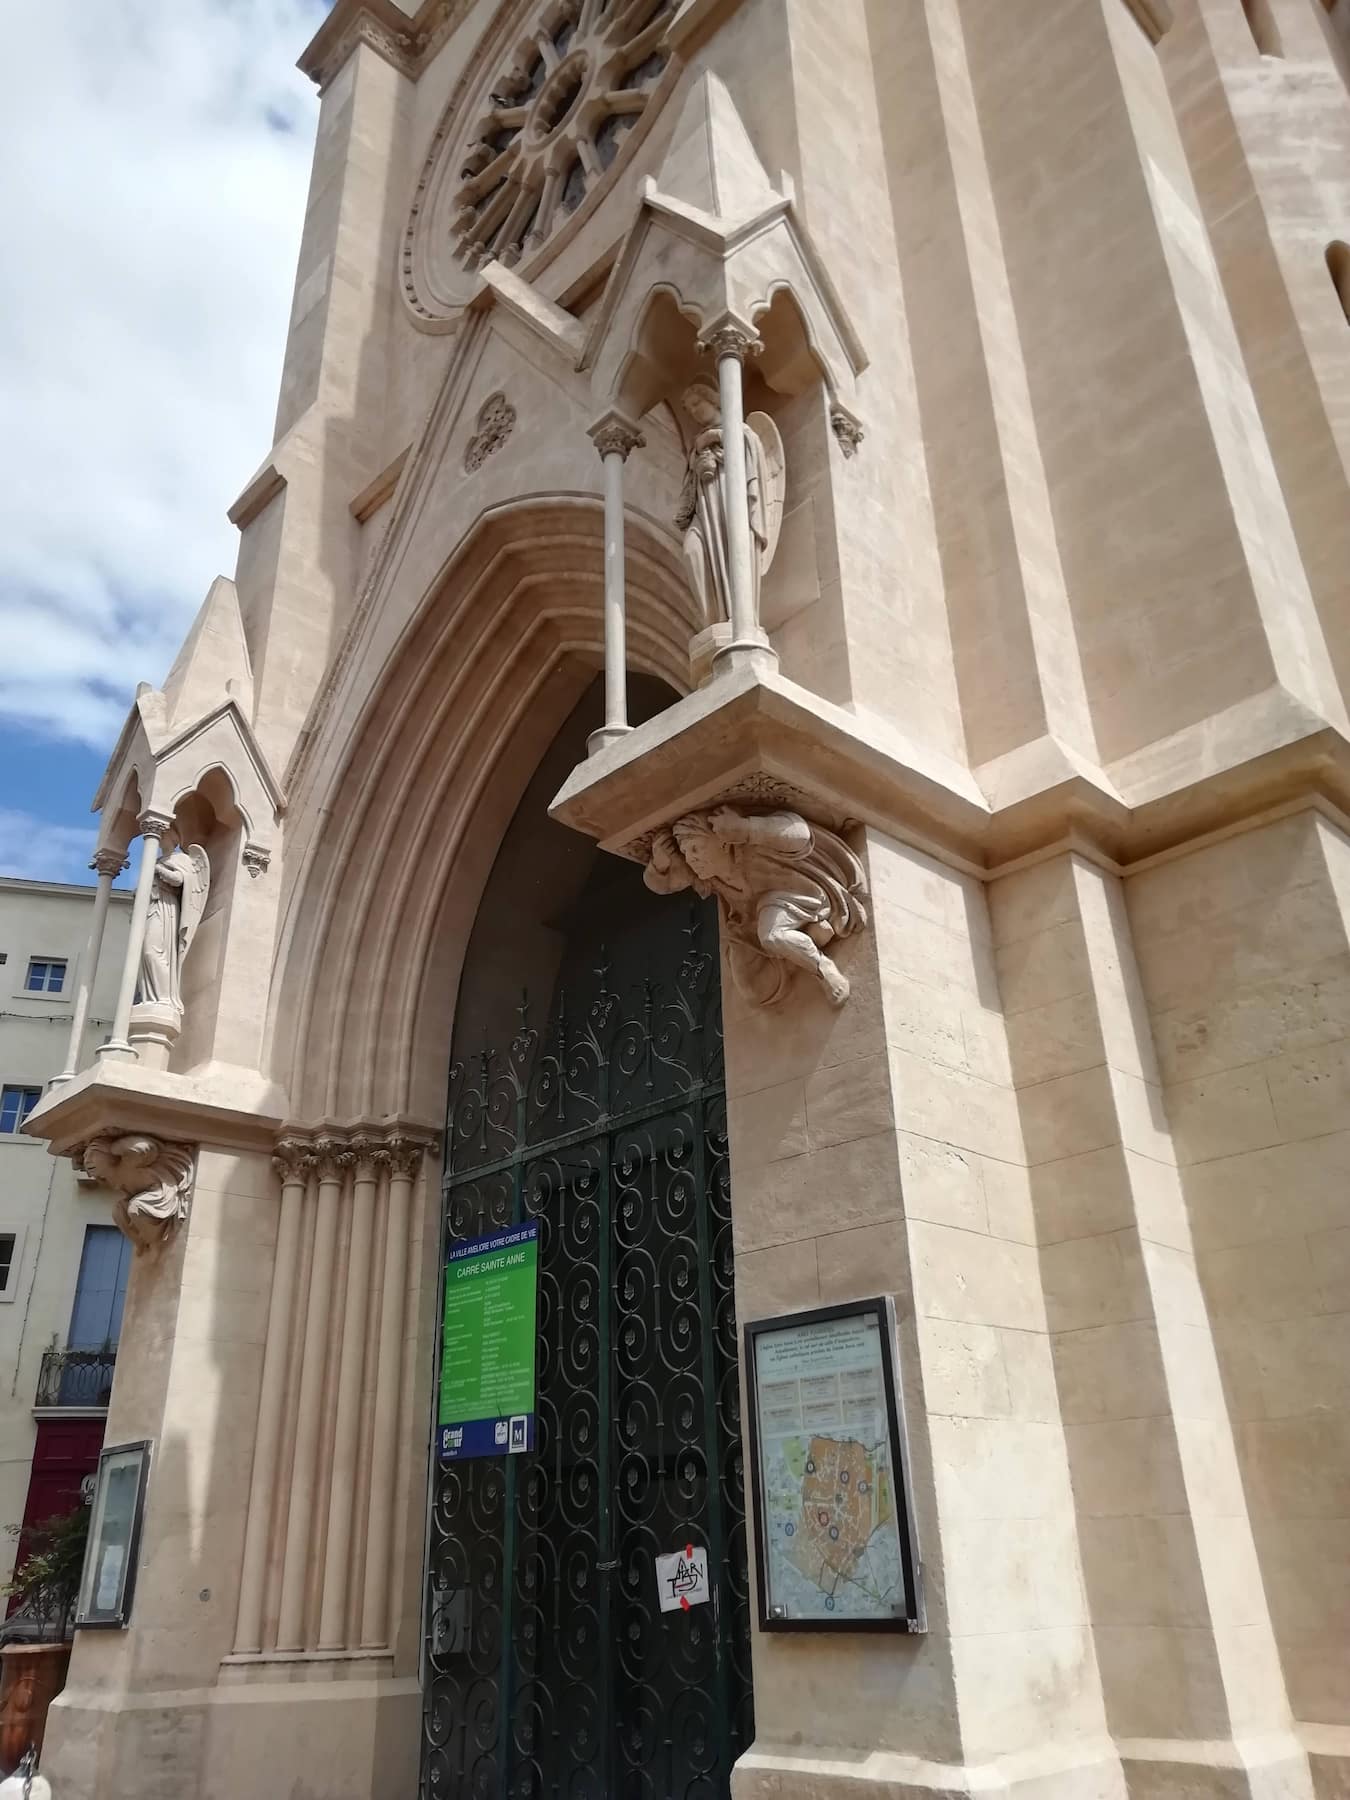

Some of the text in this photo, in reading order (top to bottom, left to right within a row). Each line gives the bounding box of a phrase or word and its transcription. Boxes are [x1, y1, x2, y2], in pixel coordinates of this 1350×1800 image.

[456, 1248, 467, 1257] VILLE
[490, 1238, 505, 1248] VOTRE
[505, 1233, 520, 1243] CADRE
[521, 1231, 528, 1239] DE
[528, 1228, 536, 1237] VIE
[457, 1252, 525, 1278] CARRÉ SAINTE ANNE
[443, 1426, 463, 1440] Grand
[514, 1429, 522, 1441] M
